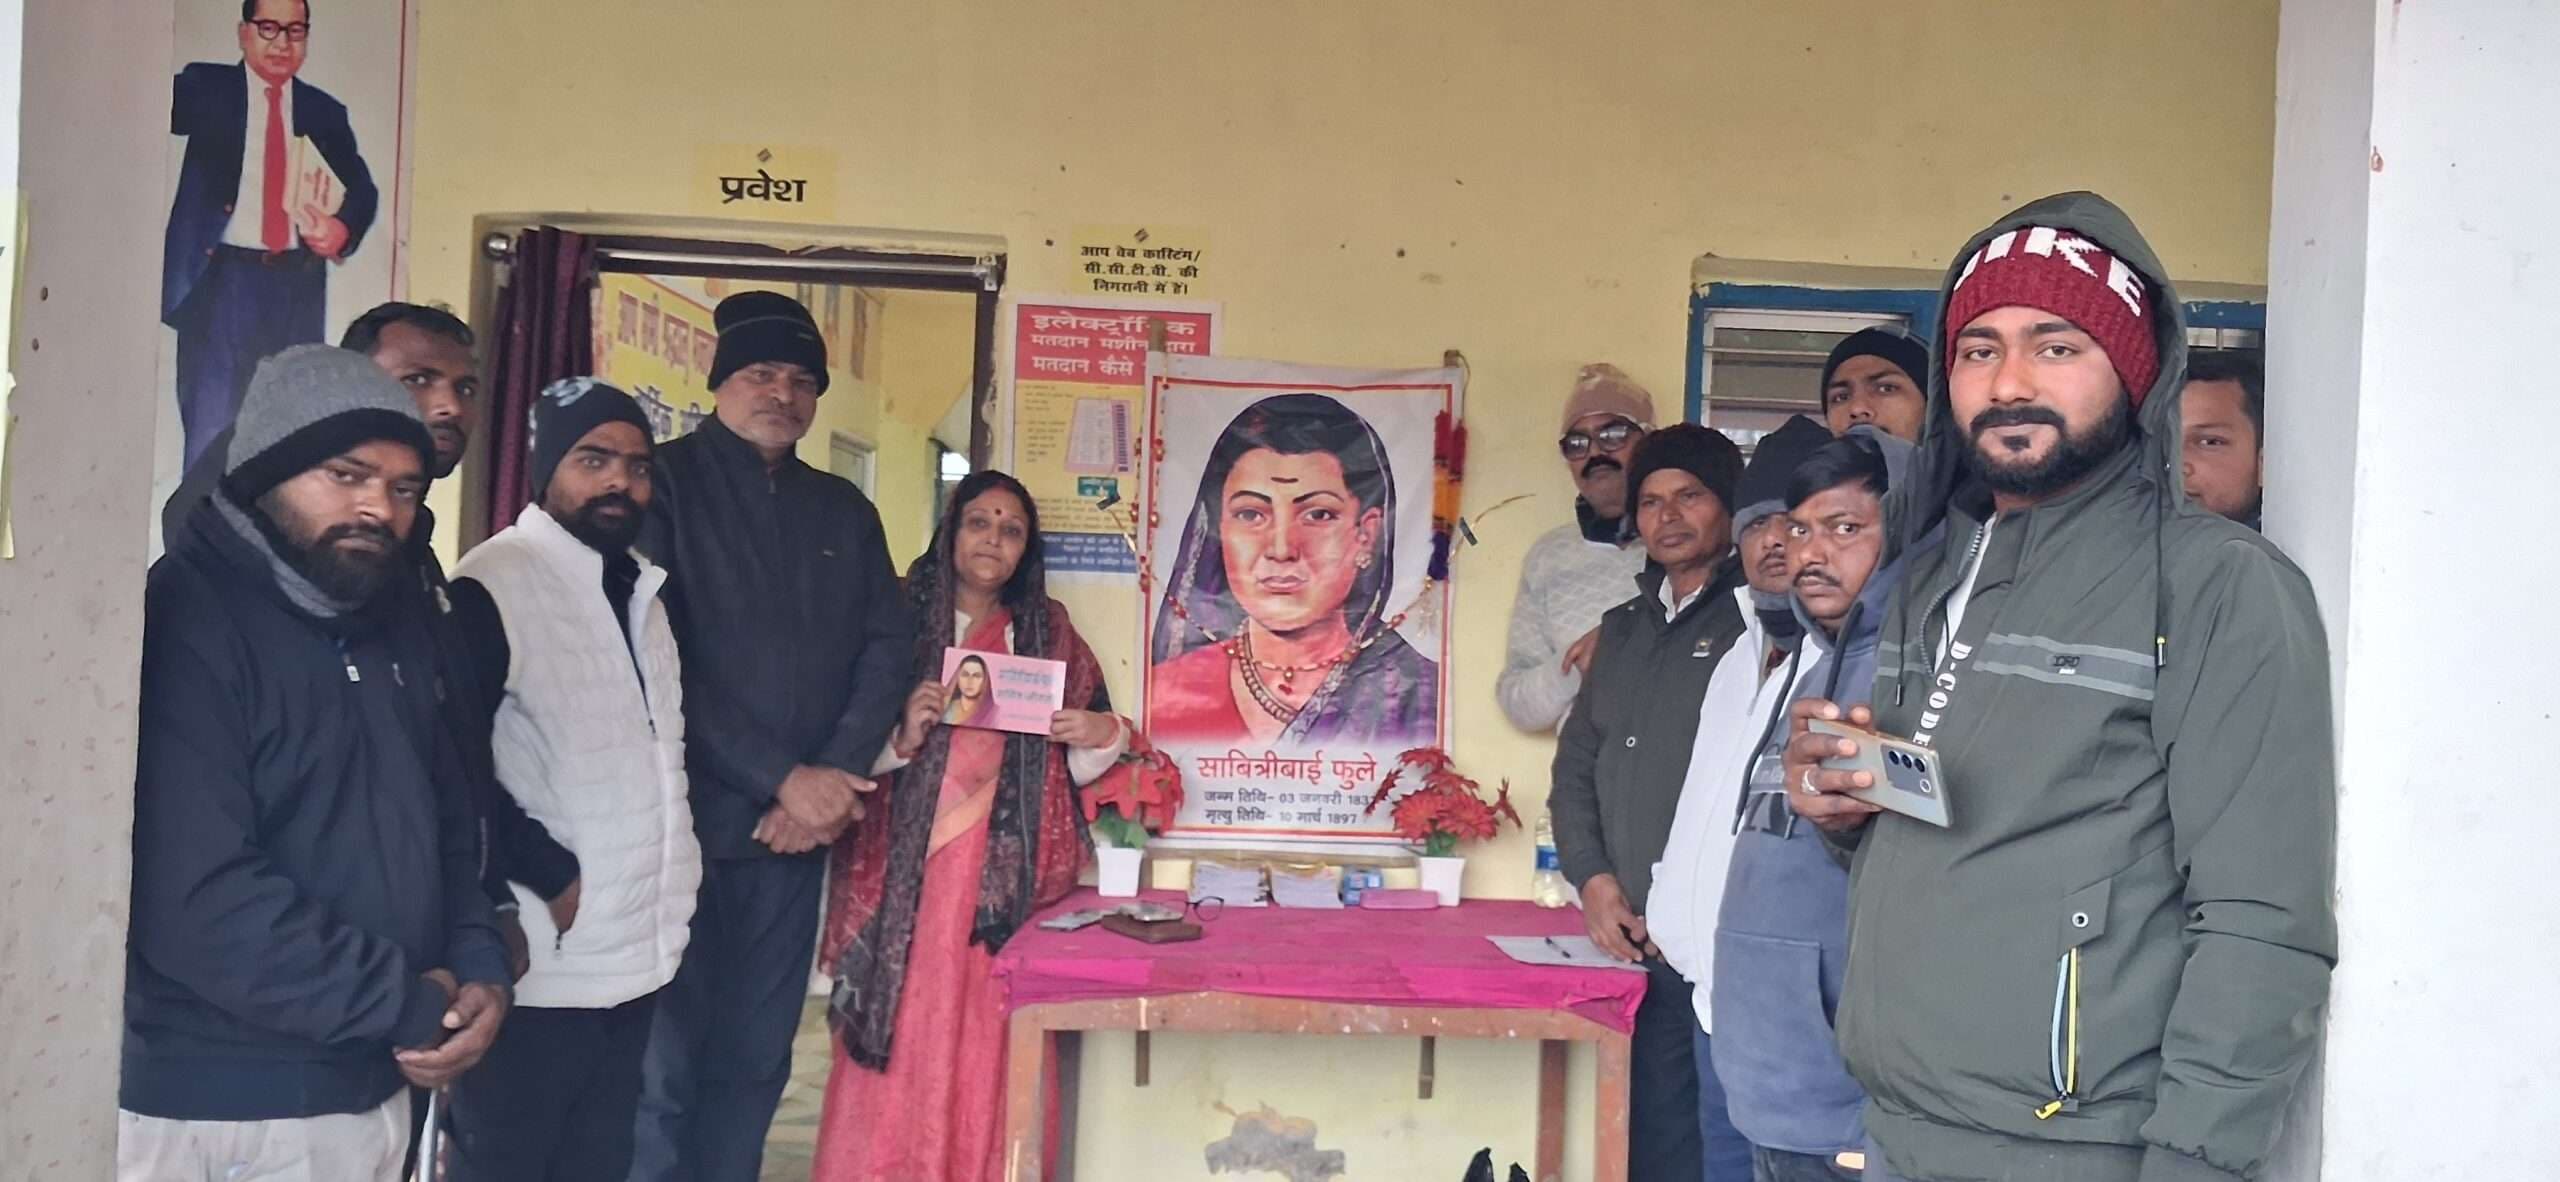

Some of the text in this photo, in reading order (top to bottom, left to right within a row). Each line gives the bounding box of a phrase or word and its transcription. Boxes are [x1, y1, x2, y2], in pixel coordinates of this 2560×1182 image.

[719, 168, 807, 204] प्रवेश
[1081, 246, 1110, 257] आप
[1177, 265, 1199, 278] की
[1093, 278, 1148, 293] निगरानी
[1155, 280, 1168, 294] में
[1030, 333, 1090, 349] मतदान
[1099, 335, 1149, 351] मशीन
[1031, 355, 1090, 374] मतदान
[1098, 354, 1134, 376] कैसे
[1912, 641, 1973, 746] D-CODE
[1331, 752, 1376, 790] फुले
[1204, 791, 1234, 802] जन्म
[1280, 793, 1295, 804] 03
[1301, 790, 1342, 805] जनवरी
[1204, 809, 1233, 825] मृत्यु
[1280, 811, 1293, 822] 10
[1297, 807, 1322, 823] मार्च
[1328, 813, 1357, 824] 1897
